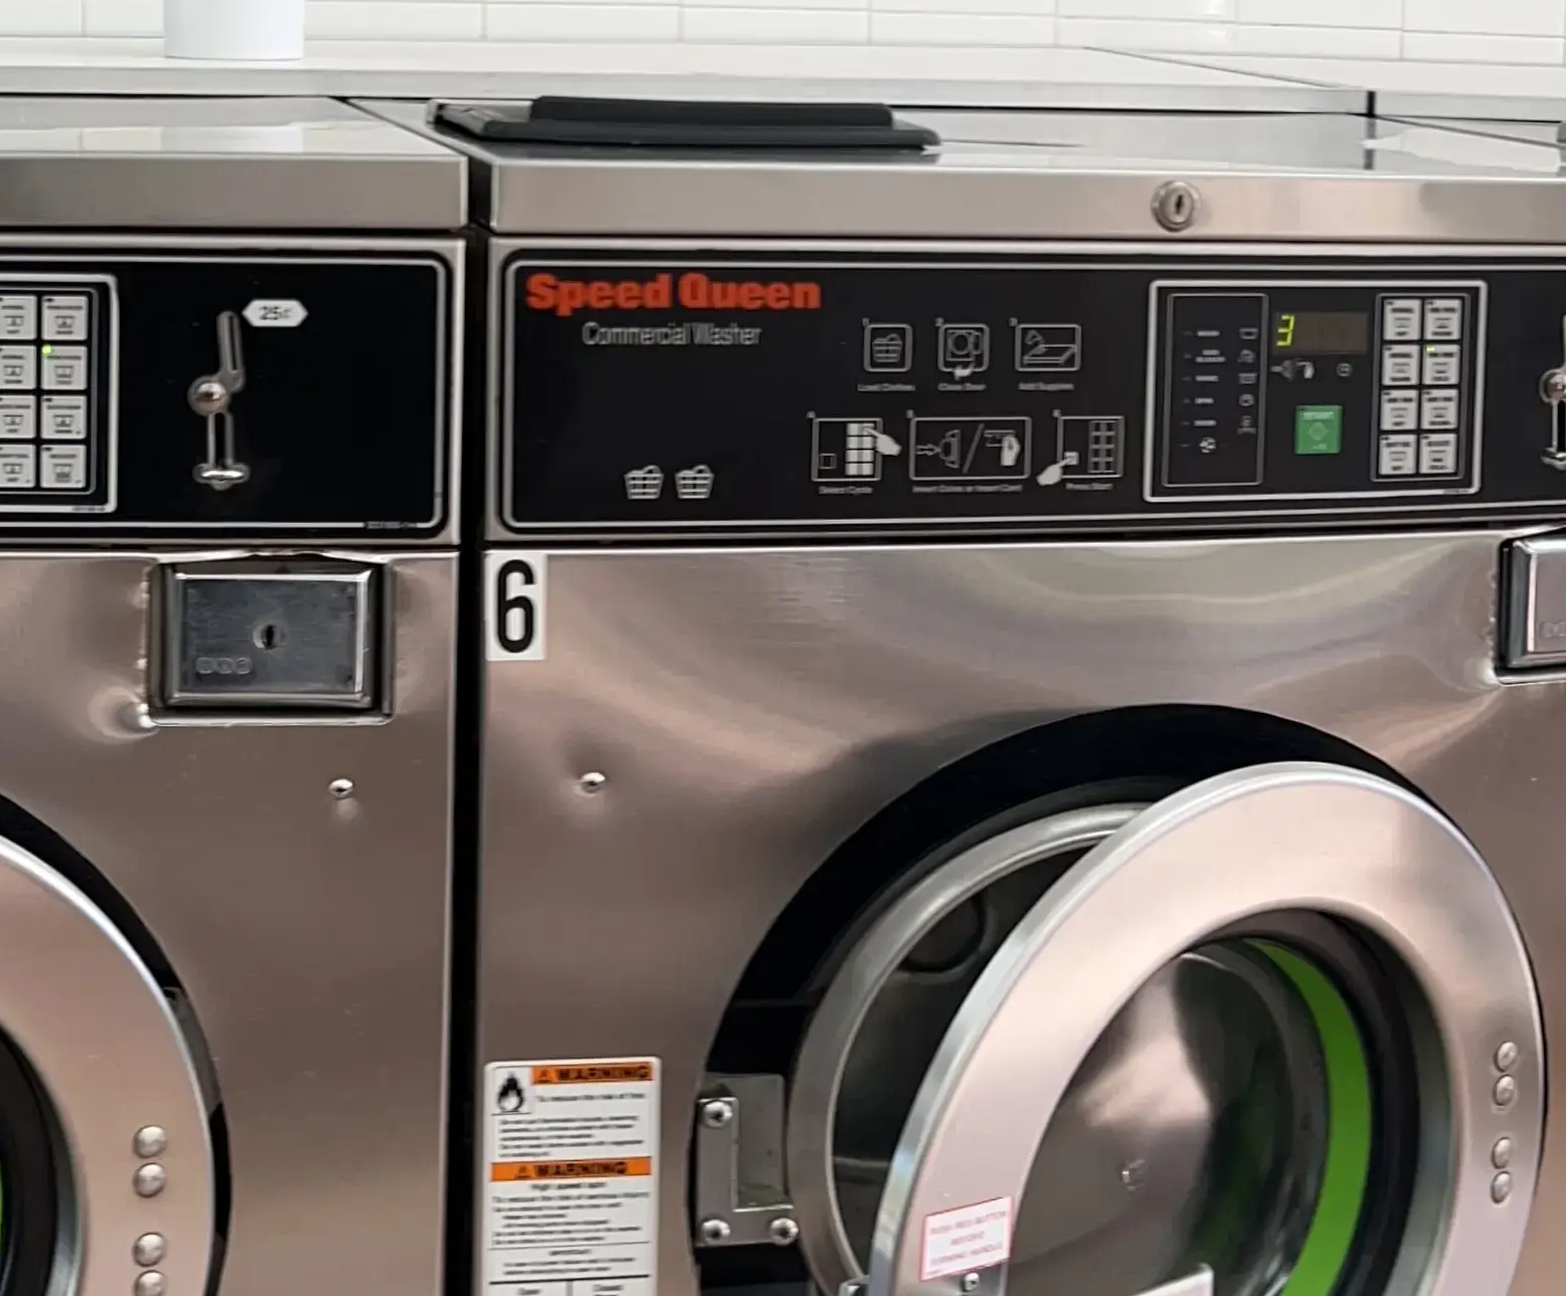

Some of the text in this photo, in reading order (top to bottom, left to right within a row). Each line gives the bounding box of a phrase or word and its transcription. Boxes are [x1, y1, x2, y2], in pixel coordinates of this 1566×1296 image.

[527, 273, 821, 316] Speed Queen
[582, 322, 761, 345] Commercial Washer
[1276, 314, 1295, 346] 3
[498, 559, 534, 653] 6
